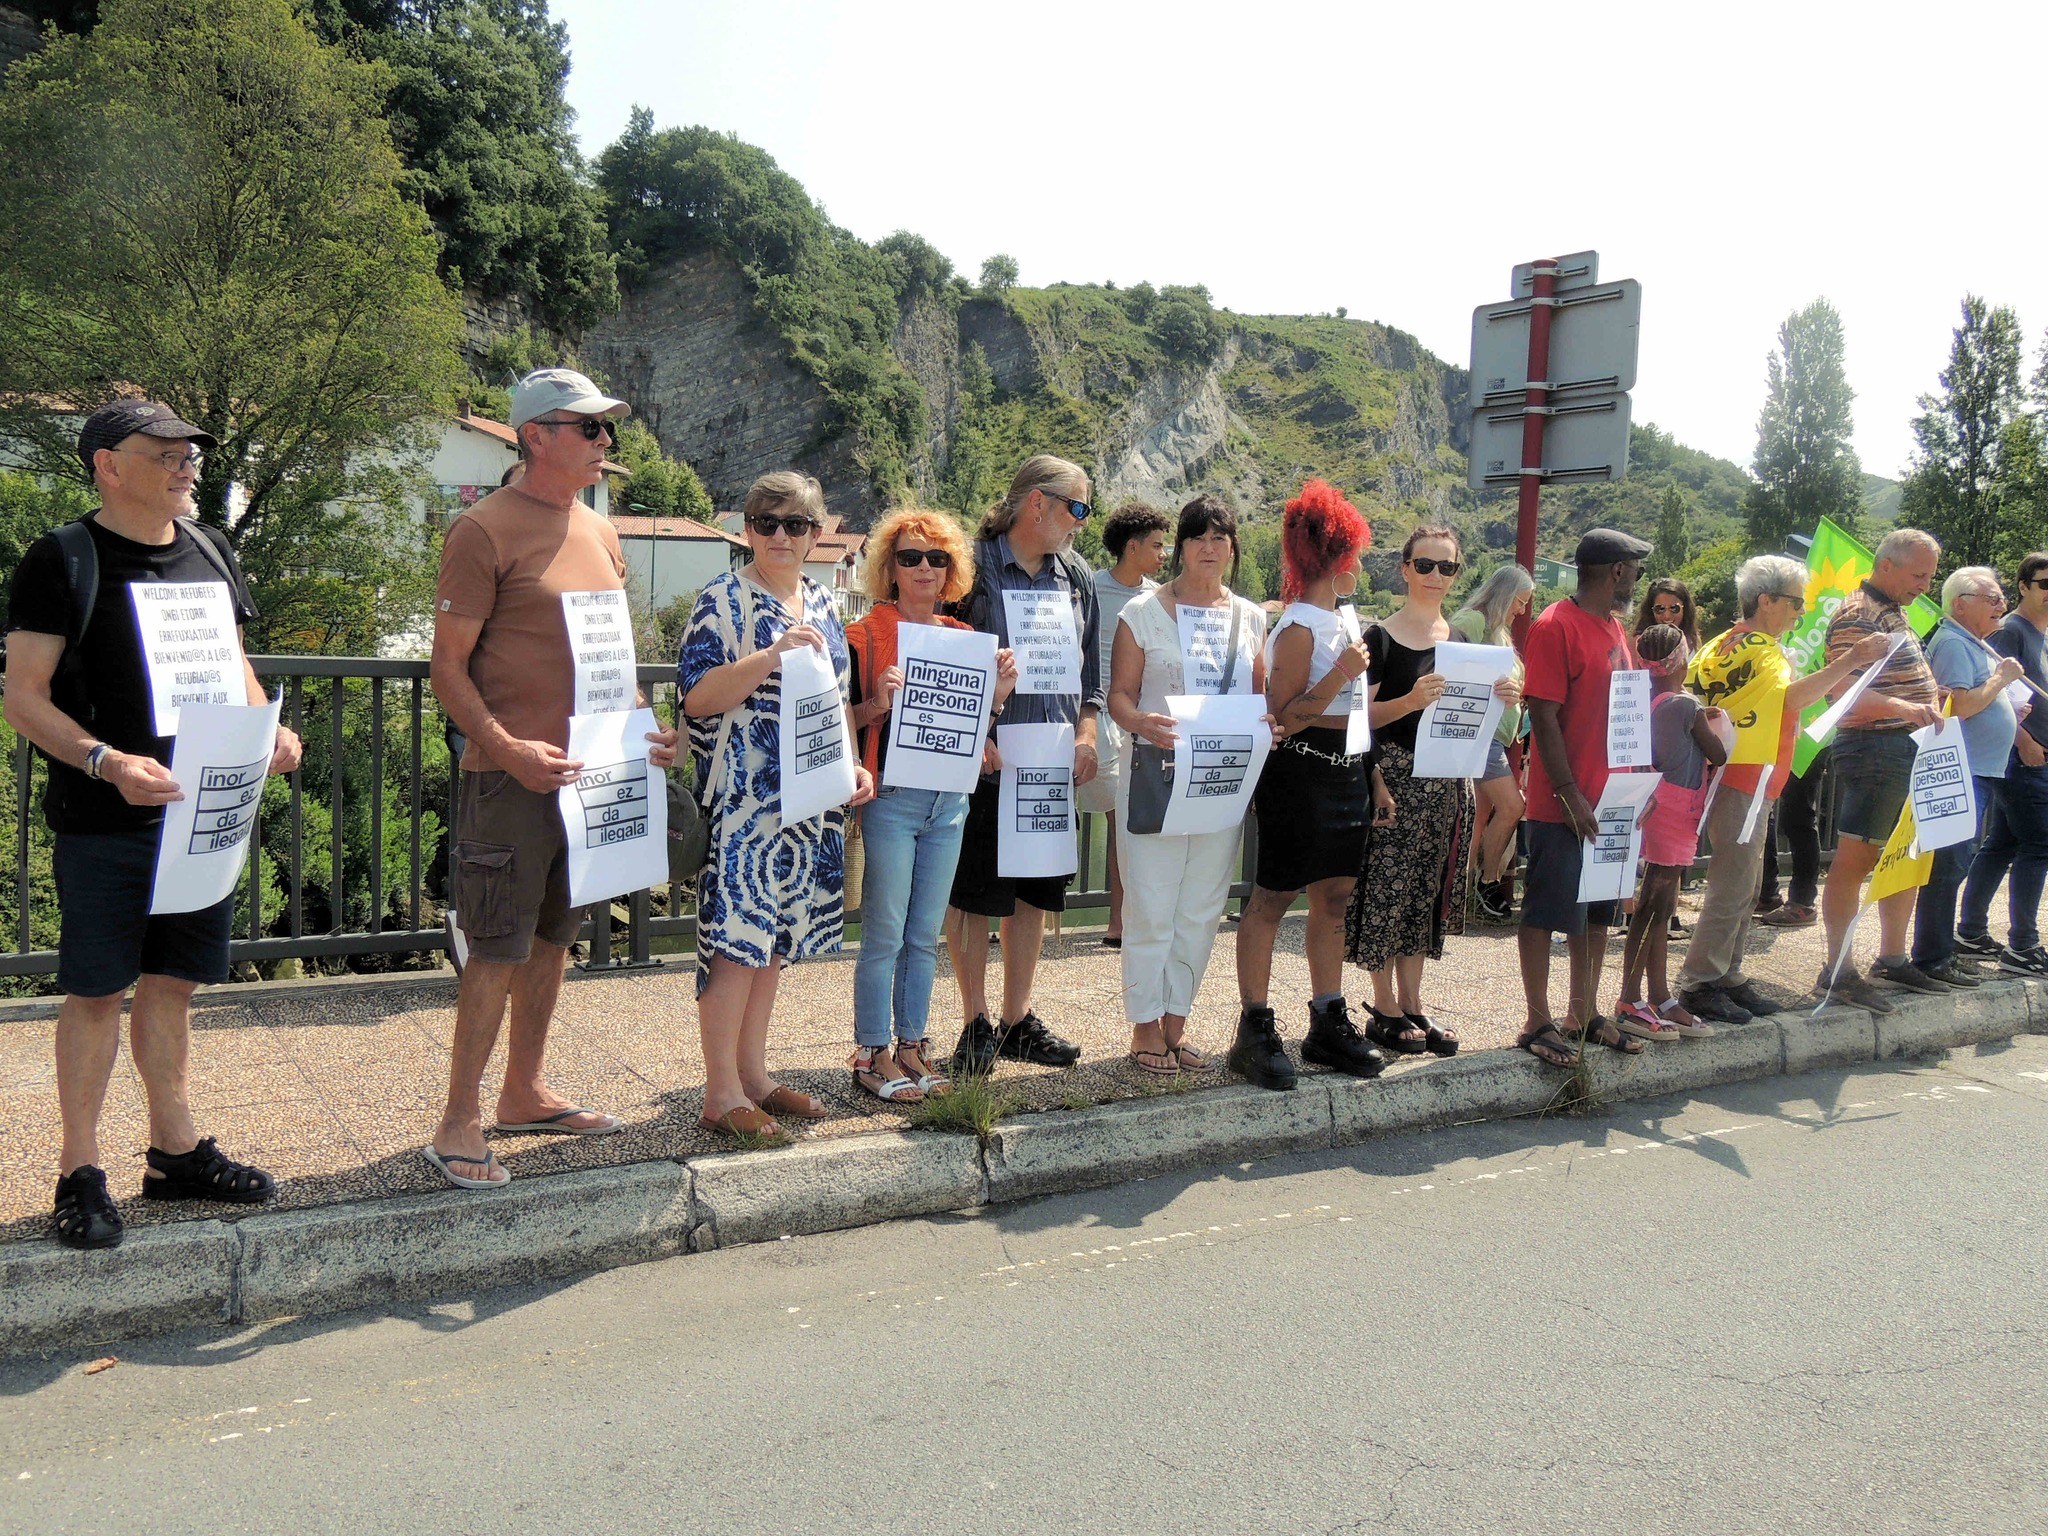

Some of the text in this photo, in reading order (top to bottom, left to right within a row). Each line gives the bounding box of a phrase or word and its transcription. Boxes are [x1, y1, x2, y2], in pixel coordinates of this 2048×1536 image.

[142, 586, 216, 600] WELCOME REFUGEES
[1010, 593, 1061, 602] WELCOME REFUGEES
[570, 594, 618, 606] WELCOME REFUGEES
[161, 608, 207, 621] ONGI ETORRI
[1182, 608, 1206, 618] WELCOME
[158, 628, 219, 642] ERREFUXIATUAK
[1014, 635, 1051, 645] BIENVENID@S
[1058, 635, 1071, 644] L@S
[154, 648, 232, 664] BIENVENID@S A L@S
[618, 648, 629, 660] L@S
[1028, 650, 1062, 660] REFUGIAD@S
[175, 670, 221, 684] REFUGIAD@S
[591, 668, 621, 682] REFUGIAD@S
[911, 662, 980, 689] ninguna
[1026, 666, 1066, 675] BIENVENUE AUX
[1196, 678, 1222, 688] BIENVENU
[1444, 683, 1466, 694] inor
[212, 692, 228, 704] AUX
[588, 686, 624, 702] BIENVENUE AUX
[908, 688, 978, 712] persona
[800, 700, 822, 716] inor
[1462, 701, 1476, 710] ez
[822, 714, 834, 726] ez
[919, 712, 934, 724] es
[1444, 712, 1460, 722] da
[1440, 725, 1476, 738] ilegala
[808, 734, 823, 750] da
[916, 726, 961, 752] ilegal
[1195, 737, 1222, 749] inor
[807, 746, 840, 768] ilegala
[1222, 756, 1237, 765] ez
[207, 770, 247, 787] inor
[579, 770, 612, 788] inor
[1021, 770, 1048, 782] inor
[1205, 769, 1221, 780] da
[1916, 768, 1960, 790] persona
[240, 787, 255, 803] ez
[617, 786, 633, 800] ez
[1048, 788, 1062, 798] ez
[1199, 782, 1238, 795] ilegala
[1924, 790, 1934, 798] es
[1034, 802, 1050, 814] da
[1927, 796, 1958, 816] ilegal
[216, 812, 238, 828] da
[602, 806, 620, 822] da
[1602, 810, 1618, 819] inor
[600, 820, 644, 842] ilegala
[1032, 817, 1068, 832] ilegala
[1614, 824, 1624, 832] ez
[1604, 837, 1615, 847] da
